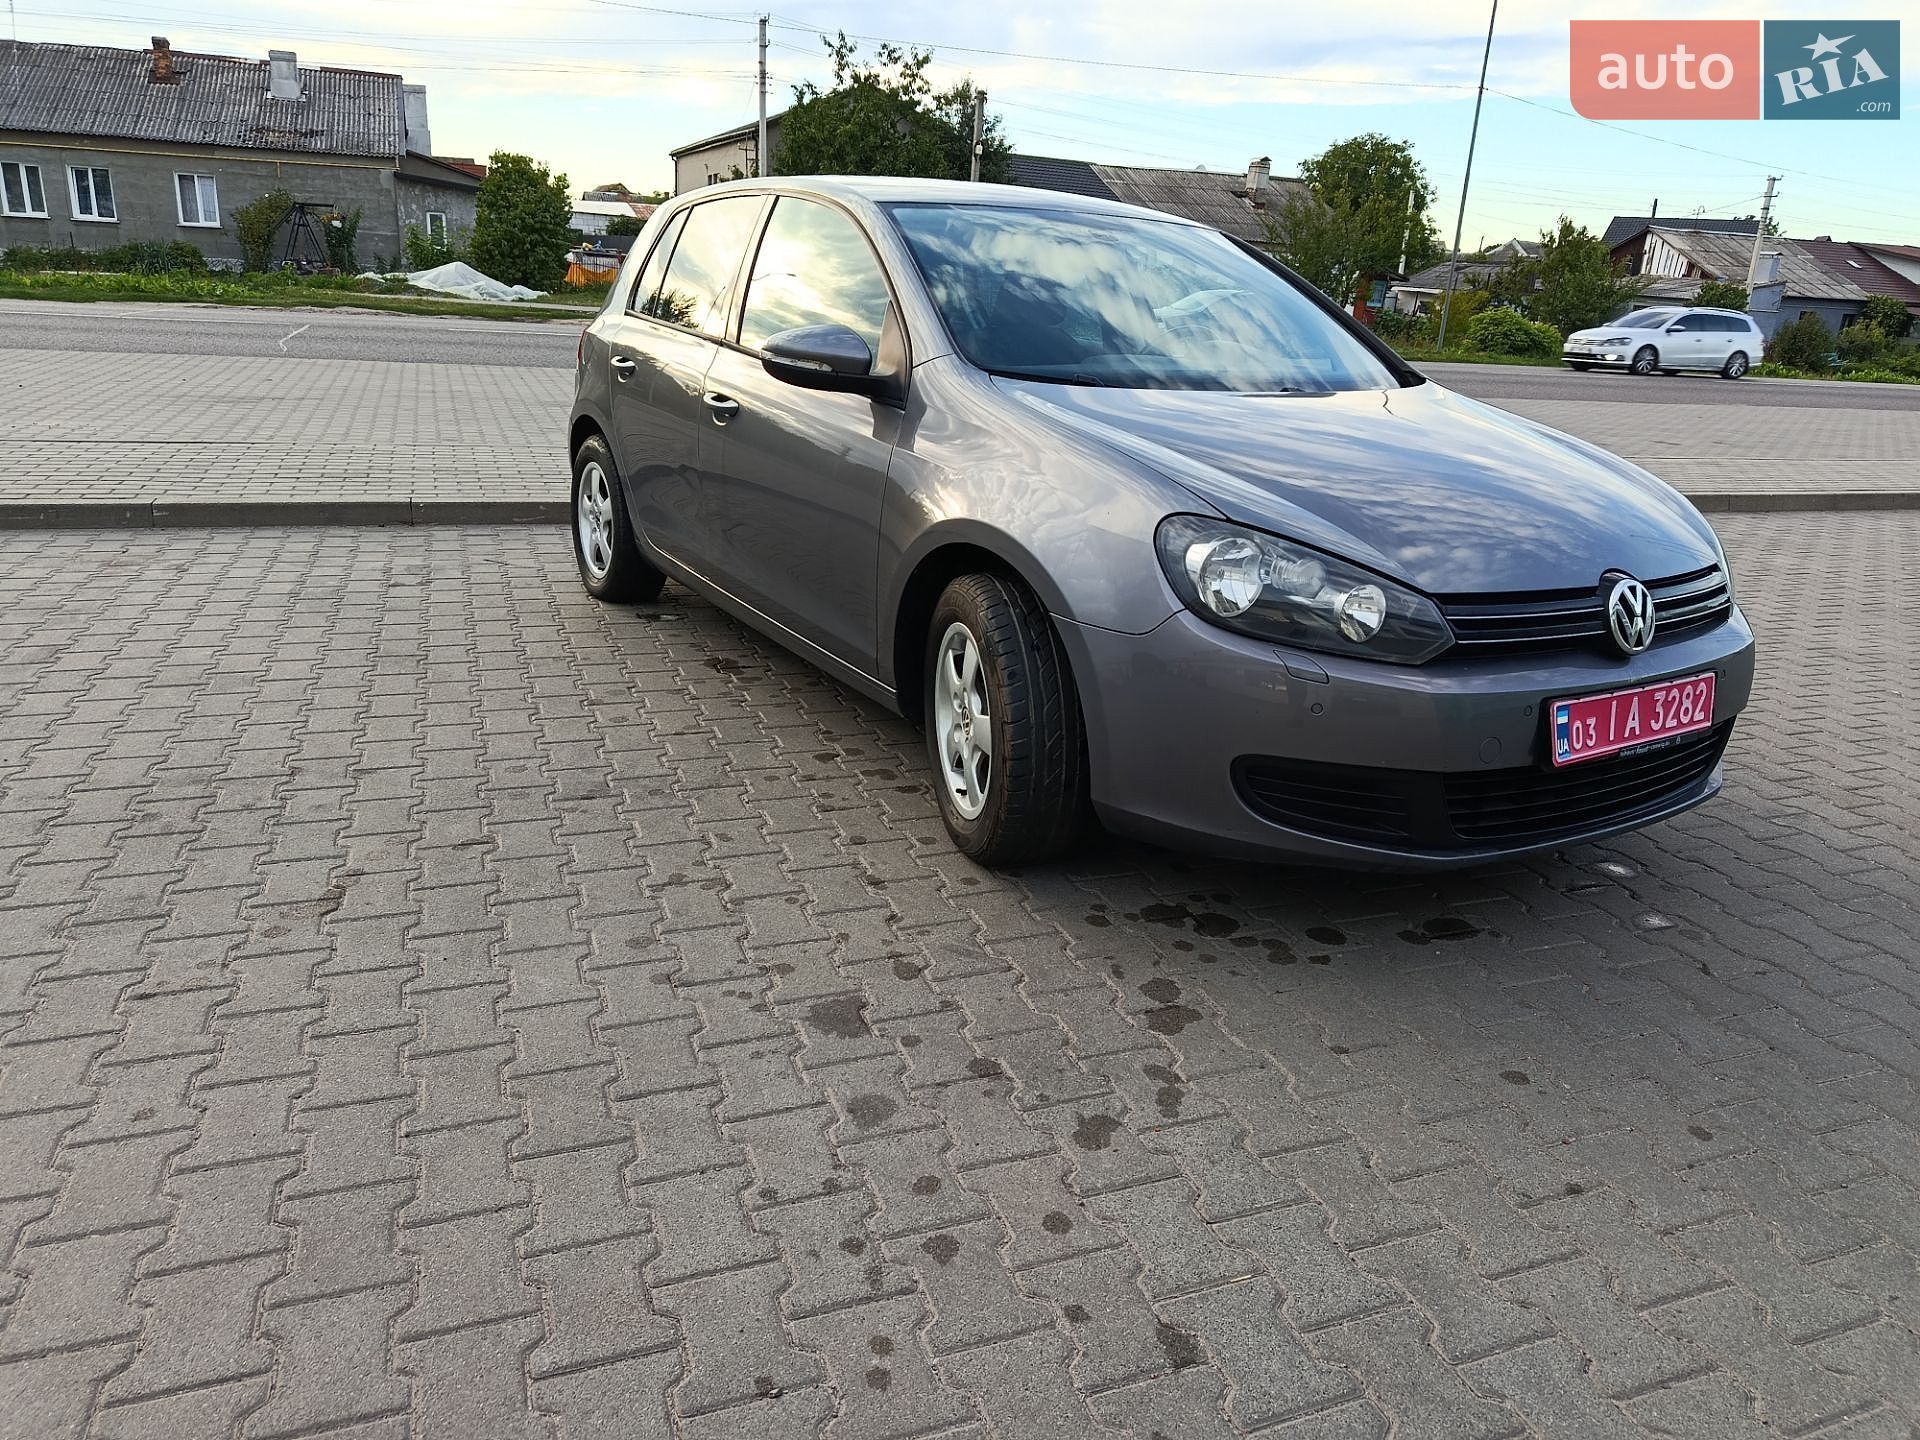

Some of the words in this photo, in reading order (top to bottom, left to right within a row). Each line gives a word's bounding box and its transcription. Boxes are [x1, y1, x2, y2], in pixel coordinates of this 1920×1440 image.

[1572, 717, 1597, 750] 03
[1650, 681, 1707, 731] 3282
[1556, 738, 1570, 753] UA
